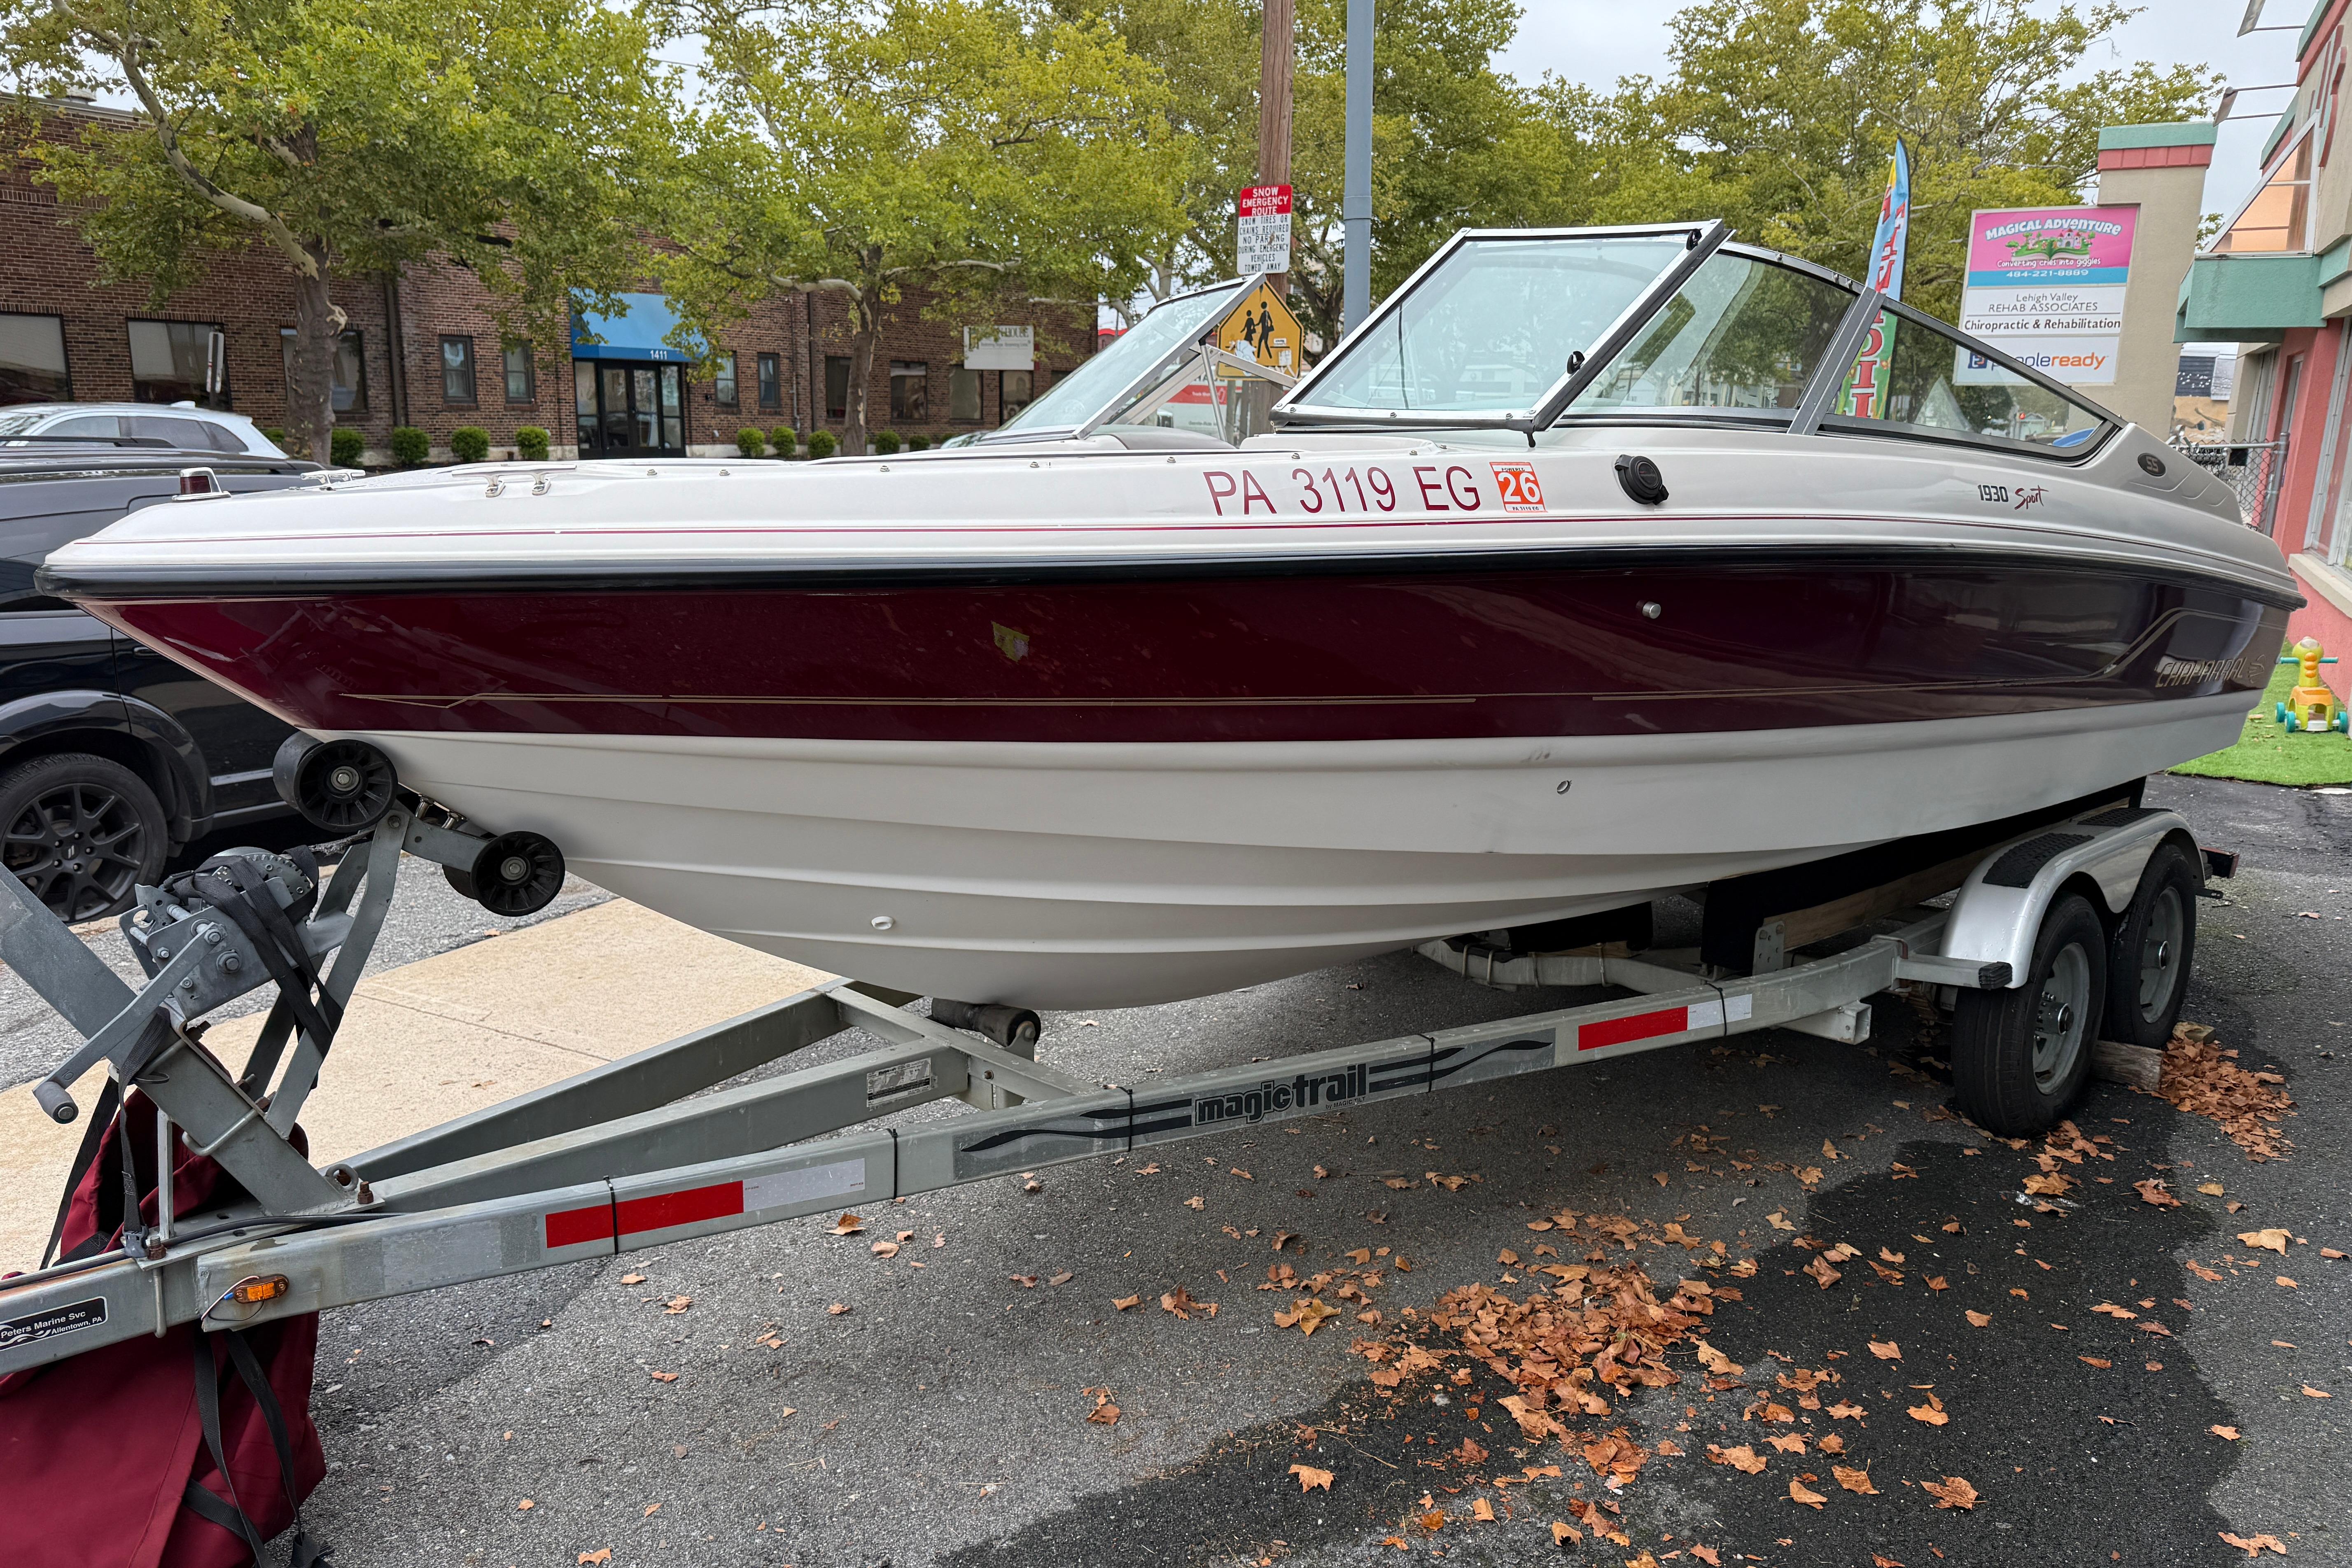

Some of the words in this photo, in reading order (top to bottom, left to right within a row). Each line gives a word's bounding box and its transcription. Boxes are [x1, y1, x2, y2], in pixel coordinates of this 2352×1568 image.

[1253, 187, 1279, 197] SNOW
[1242, 196, 1288, 208] EMERGENCY
[1252, 206, 1277, 216] ROUTE
[1241, 217, 1255, 226] SNOW
[1261, 215, 1276, 224] TIRES
[1239, 226, 1258, 235] CHAINS
[1262, 224, 1288, 234] REQUIRED
[1986, 219, 2042, 240] MAGICAL
[1243, 236, 1251, 244] NO
[1255, 234, 1285, 244] PARNG
[1238, 245, 1255, 254] DURING
[1260, 244, 1288, 253] EMERGENCY
[1251, 254, 1275, 263] VEHICLES
[1997, 259, 2037, 268] Converting
[2076, 257, 2101, 266] giggles
[1245, 264, 1261, 272] TOWED
[1266, 263, 1281, 271] AWAY
[2006, 269, 2089, 278] 484-221-8889
[2016, 294, 2047, 303] Lehigh
[2050, 293, 2079, 301] Valley
[1988, 303, 2026, 313] REHAB
[2029, 302, 2098, 312] ASSOCIATES
[1965, 319, 2029, 332] Chiropractic
[2032, 320, 2041, 329] &
[2044, 317, 2121, 329] Rehabilitation
[650, 350, 667, 360] 1411
[1203, 470, 1276, 516] PA
[1292, 466, 1396, 513] 3119
[1412, 466, 1481, 511] EG
[1498, 472, 1540, 503] 26
[1978, 485, 2009, 502] 1930
[2014, 485, 2049, 510] Sport
[2155, 657, 2247, 688] CHAPARRAL
[1195, 1063, 1366, 1126] magictrail
[1334, 1099, 1353, 1108] MAGIC
[1, 1325, 32, 1338] Peters
[34, 1316, 66, 1330] Marine
[68, 1311, 86, 1320] Svc
[51, 1320, 91, 1334] Allentown,
